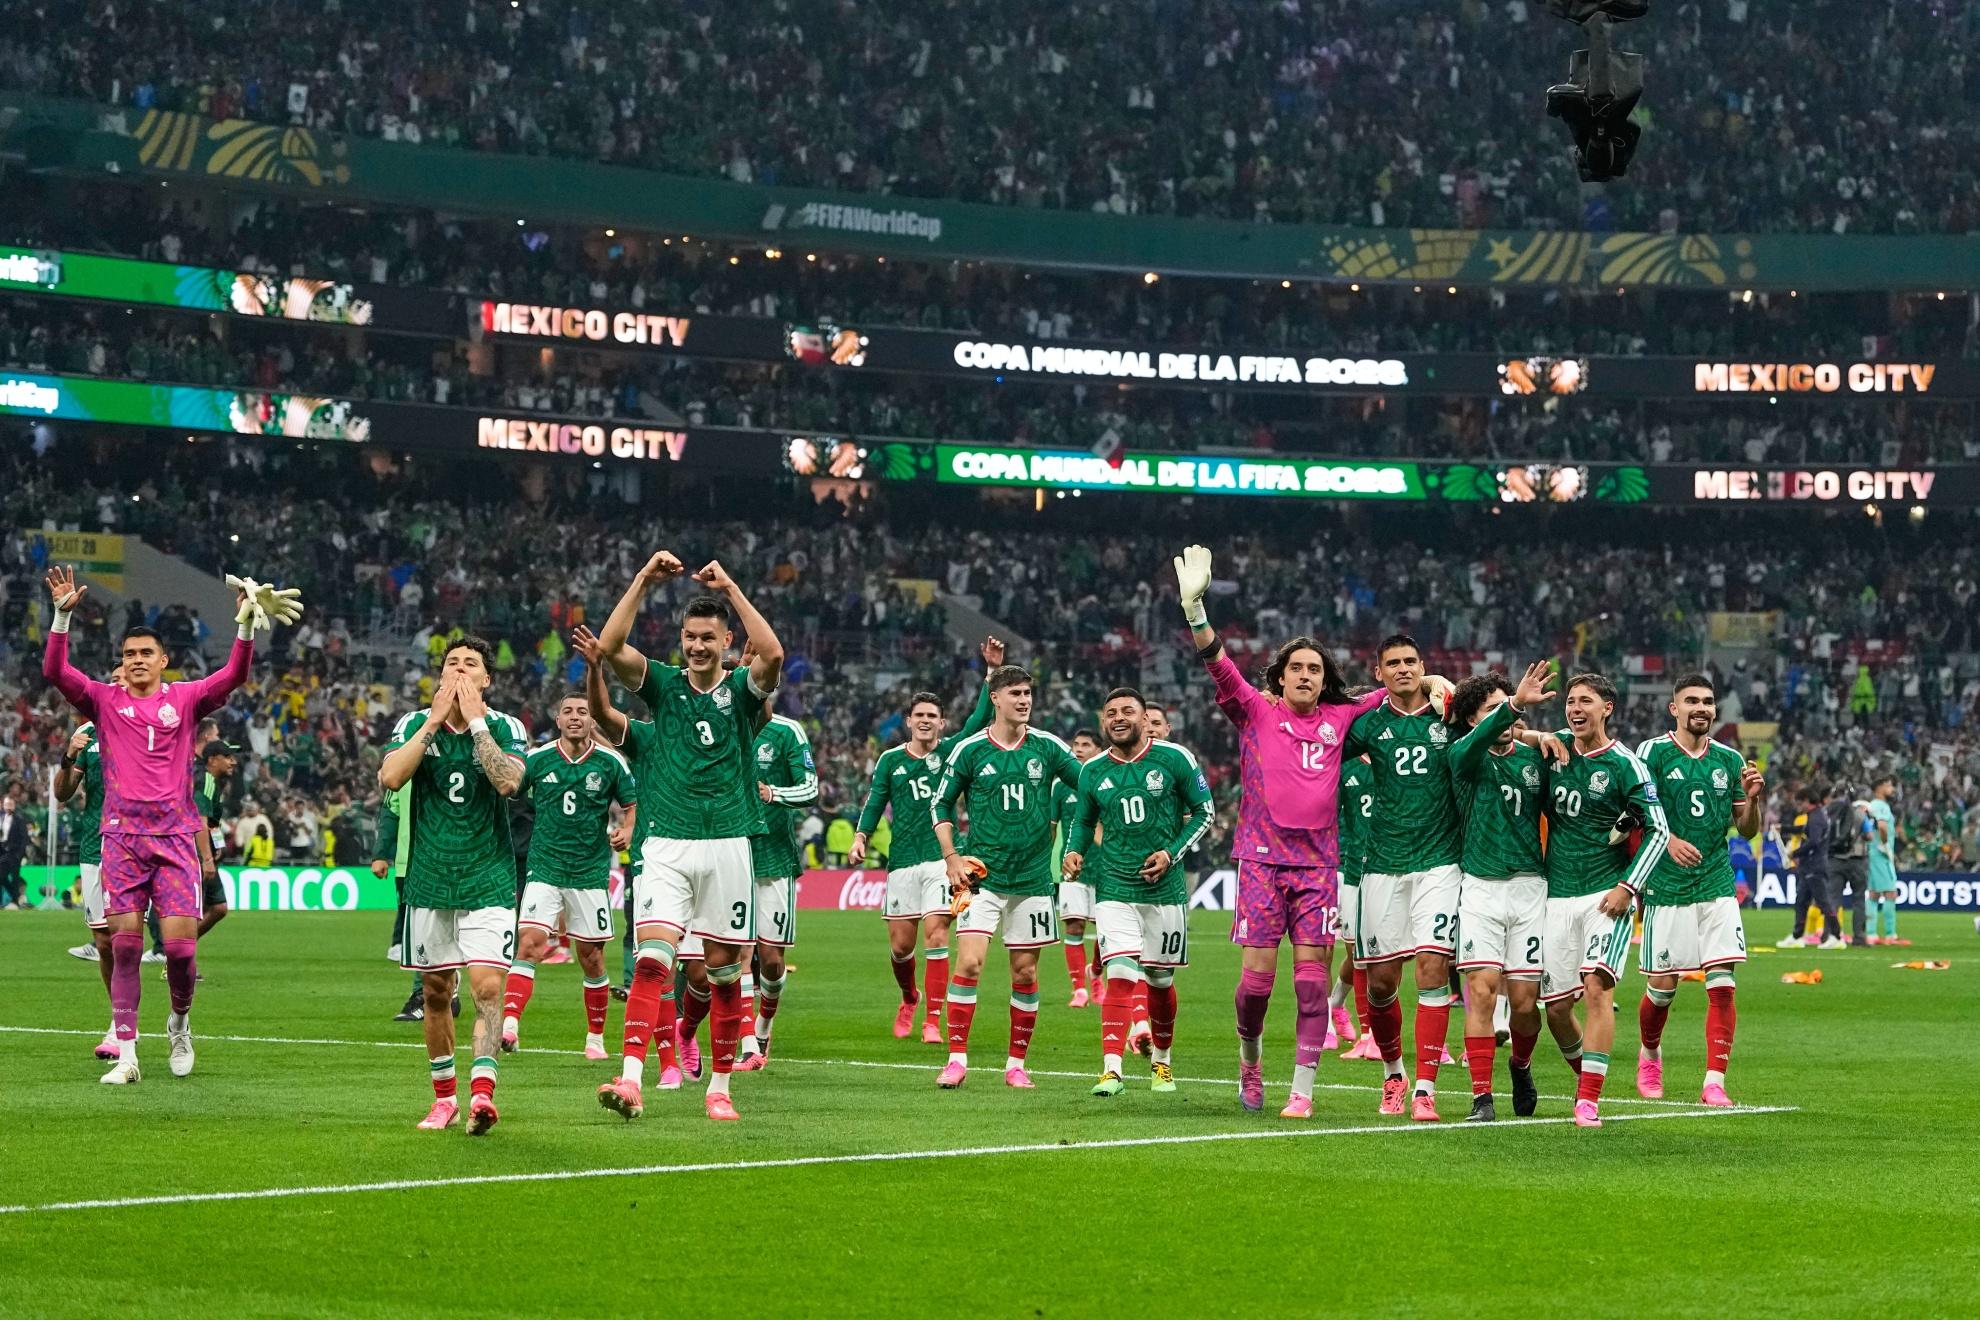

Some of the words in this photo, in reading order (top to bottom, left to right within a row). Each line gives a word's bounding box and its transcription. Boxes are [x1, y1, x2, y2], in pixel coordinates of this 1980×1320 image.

[801, 202, 941, 242] #FIFAWorldCup
[481, 301, 608, 341] MEXICO
[613, 312, 689, 347] CITY
[953, 341, 1030, 371] COPA
[1031, 346, 1157, 378] MUNDIAL
[1158, 352, 1197, 380] DE
[1198, 354, 1238, 381] LA
[1239, 356, 1302, 383] FIFA
[1694, 363, 1841, 392] MEXICO
[1848, 363, 1936, 392] CITY
[478, 417, 606, 457] MEXICO
[611, 428, 688, 461] CITY
[952, 451, 1029, 481] COPA
[1157, 460, 1196, 488] DE
[1197, 462, 1237, 489] LA
[1238, 463, 1301, 491] FIFA
[1848, 471, 1936, 501] CITY
[146, 725, 155, 751] 1
[695, 720, 715, 746] 3
[1301, 741, 1325, 769] 12
[1395, 745, 1428, 776] 22
[448, 771, 465, 803] 2
[908, 776, 932, 801] 15
[1001, 783, 1024, 811] 14
[1554, 785, 1582, 818] 20
[563, 790, 577, 815] 6
[1121, 795, 1145, 825] 10
[1690, 789, 1705, 818] 5
[596, 904, 608, 931] 6
[730, 901, 747, 930] 3
[773, 911, 787, 936] 4
[1029, 911, 1050, 939] 14
[502, 929, 514, 961] 2
[1160, 930, 1182, 956] 10
